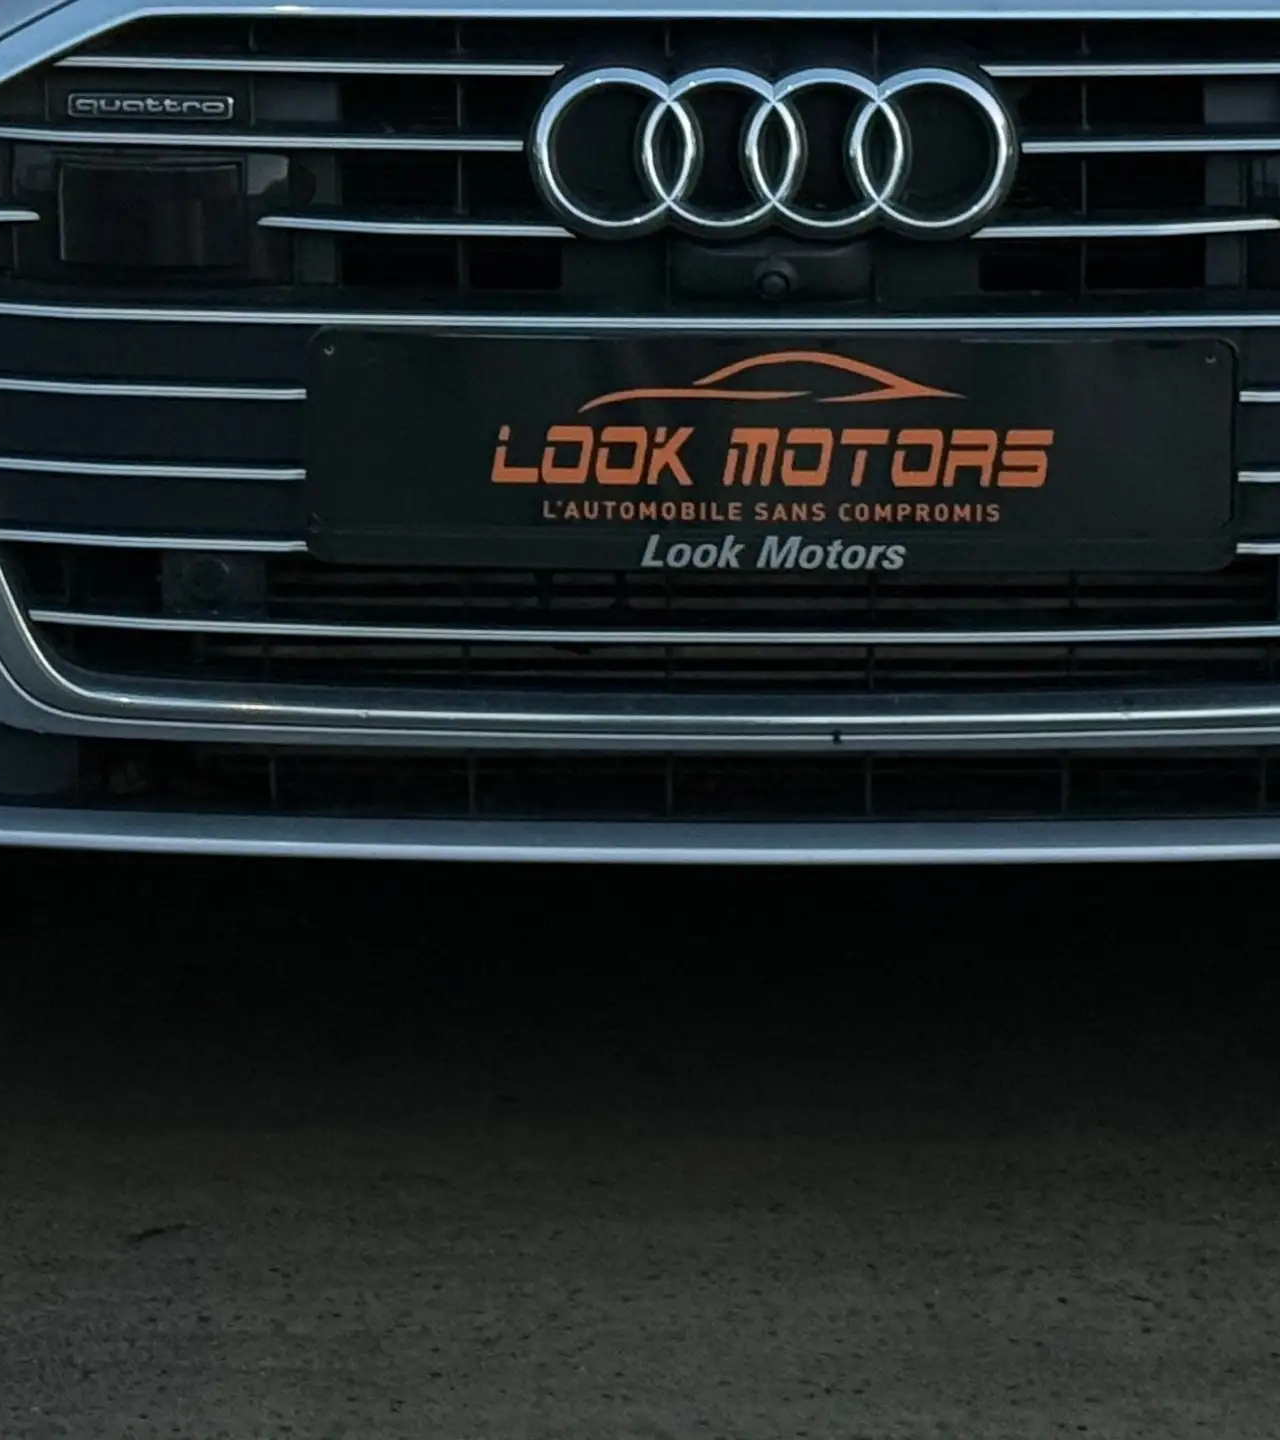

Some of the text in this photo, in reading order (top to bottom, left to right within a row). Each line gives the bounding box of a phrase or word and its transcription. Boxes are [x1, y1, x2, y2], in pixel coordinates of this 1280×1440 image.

[74, 97, 225, 114] quattro
[491, 424, 1054, 489] LOOK MOTORS
[543, 500, 1000, 524] L'AUTOMOBILE SANS COMPROMIS
[641, 534, 907, 571] Look Motors
